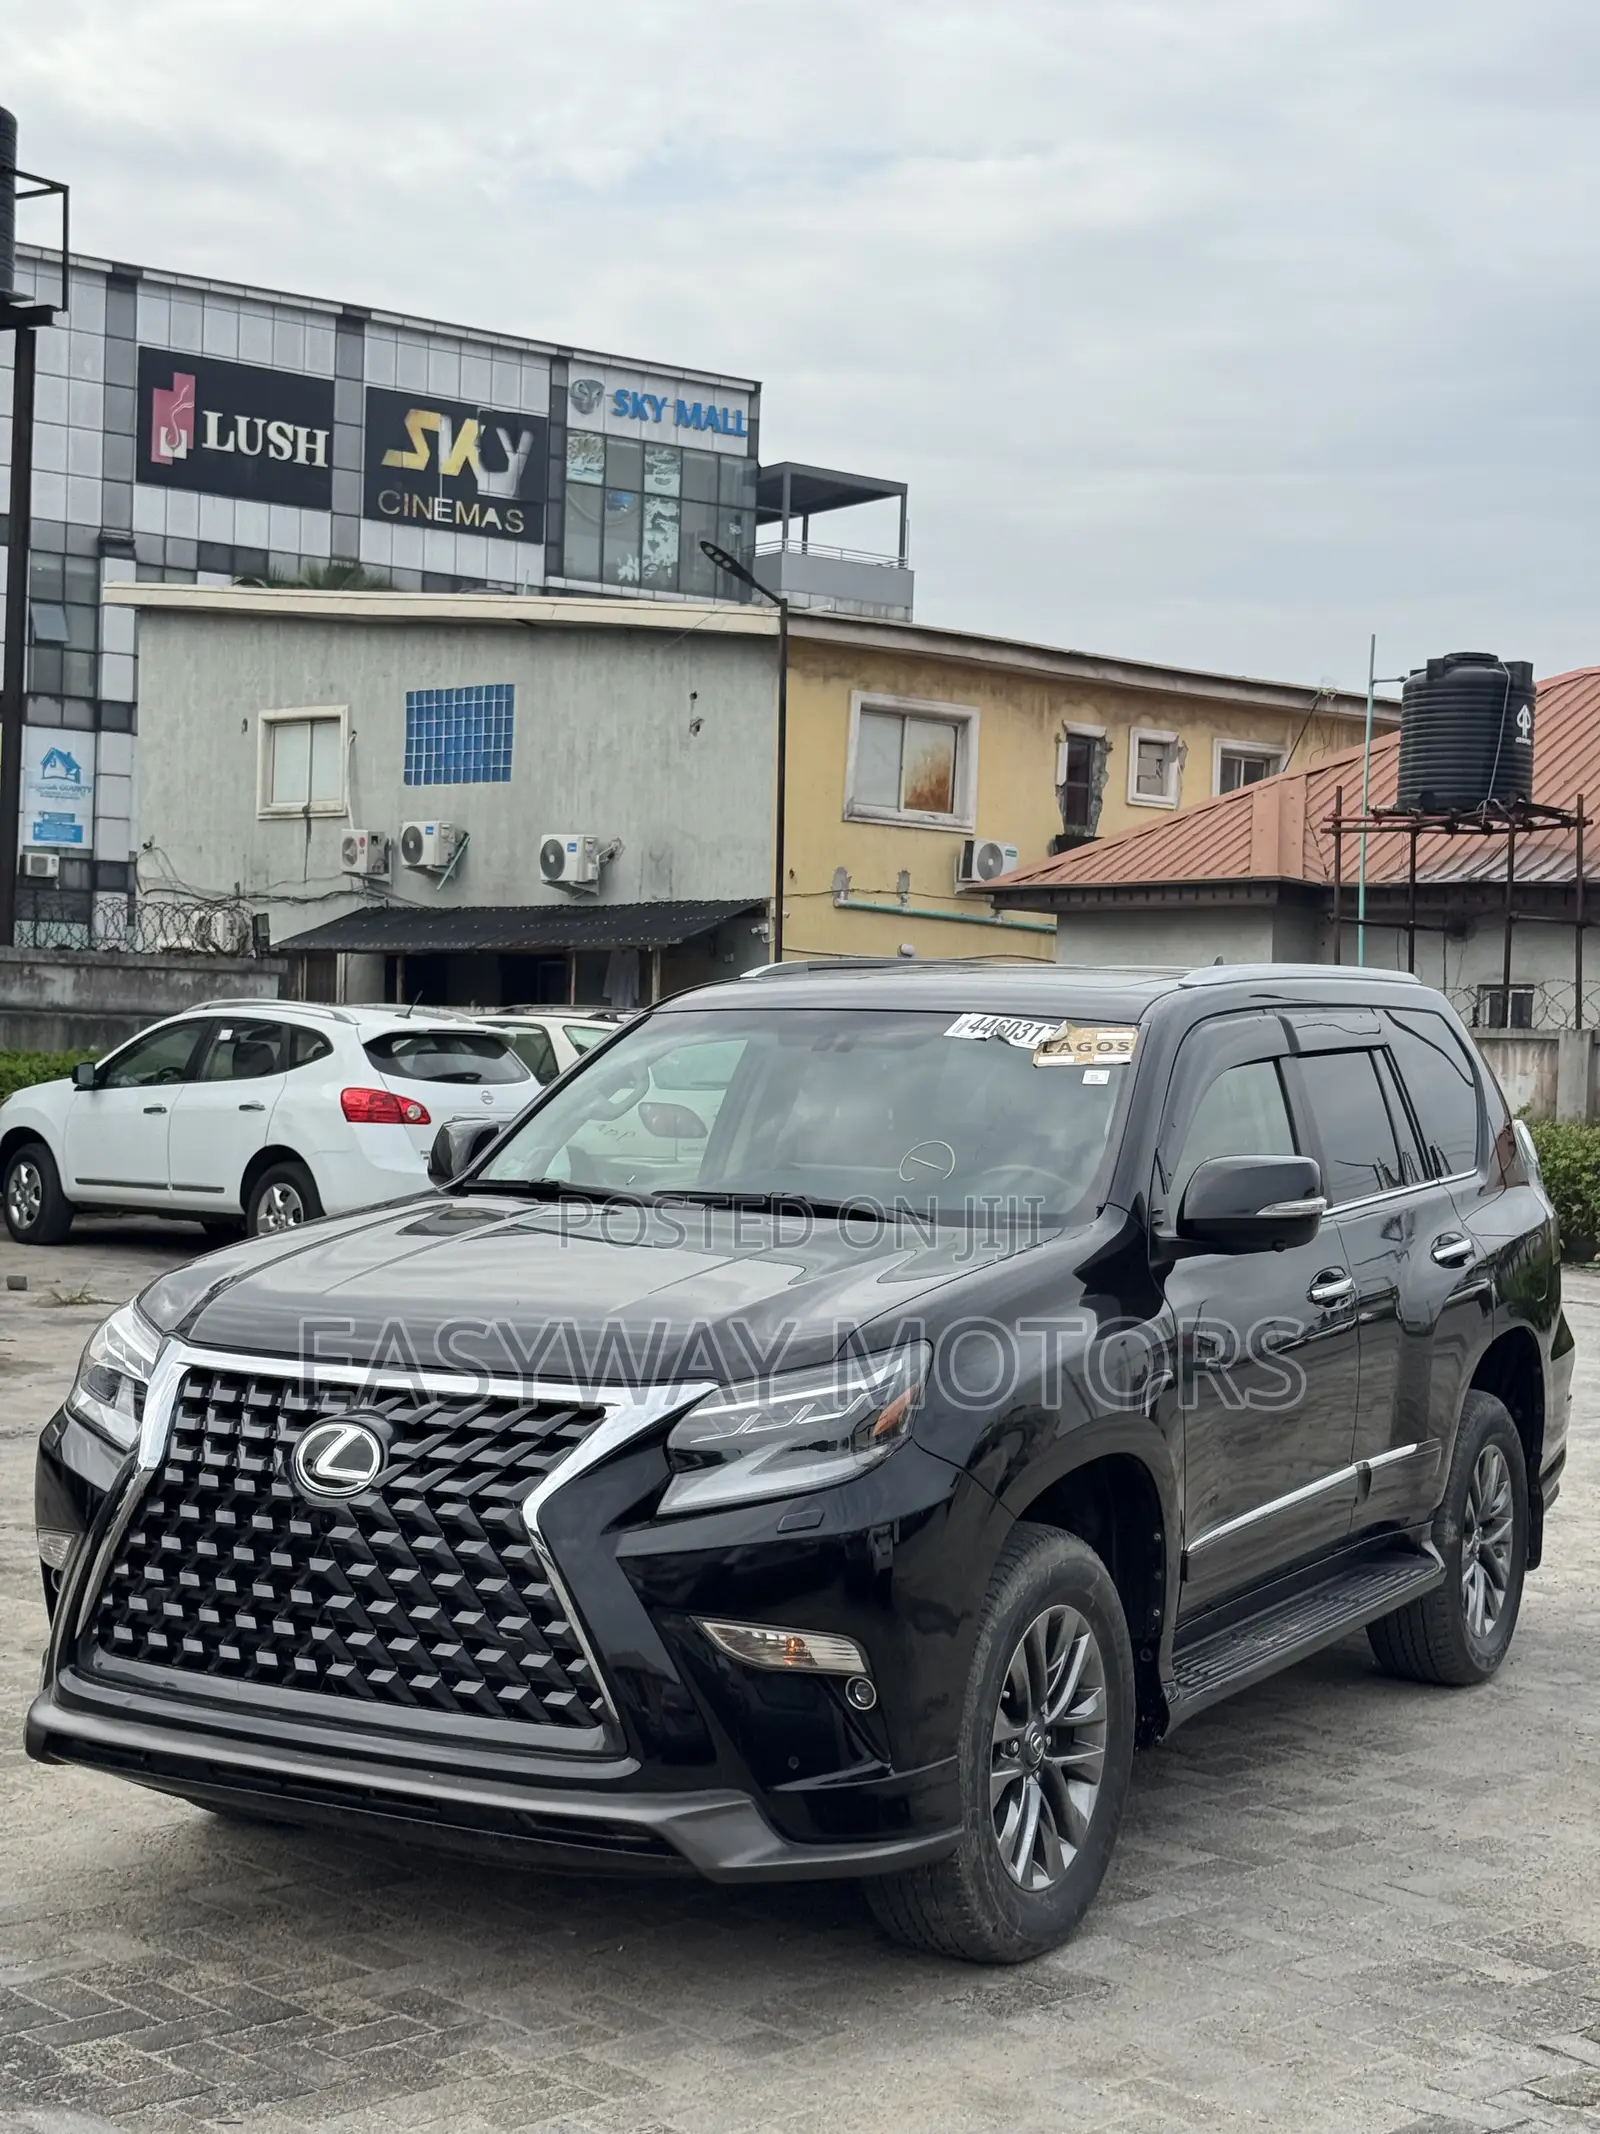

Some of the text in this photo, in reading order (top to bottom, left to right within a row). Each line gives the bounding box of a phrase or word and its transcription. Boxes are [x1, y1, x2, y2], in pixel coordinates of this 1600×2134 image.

[612, 389, 748, 437] SKY MALL
[201, 410, 330, 468] LUSH
[381, 408, 534, 500] SKY
[378, 489, 524, 533] CINEMAS
[1042, 1041, 1131, 1054] LAGOS
